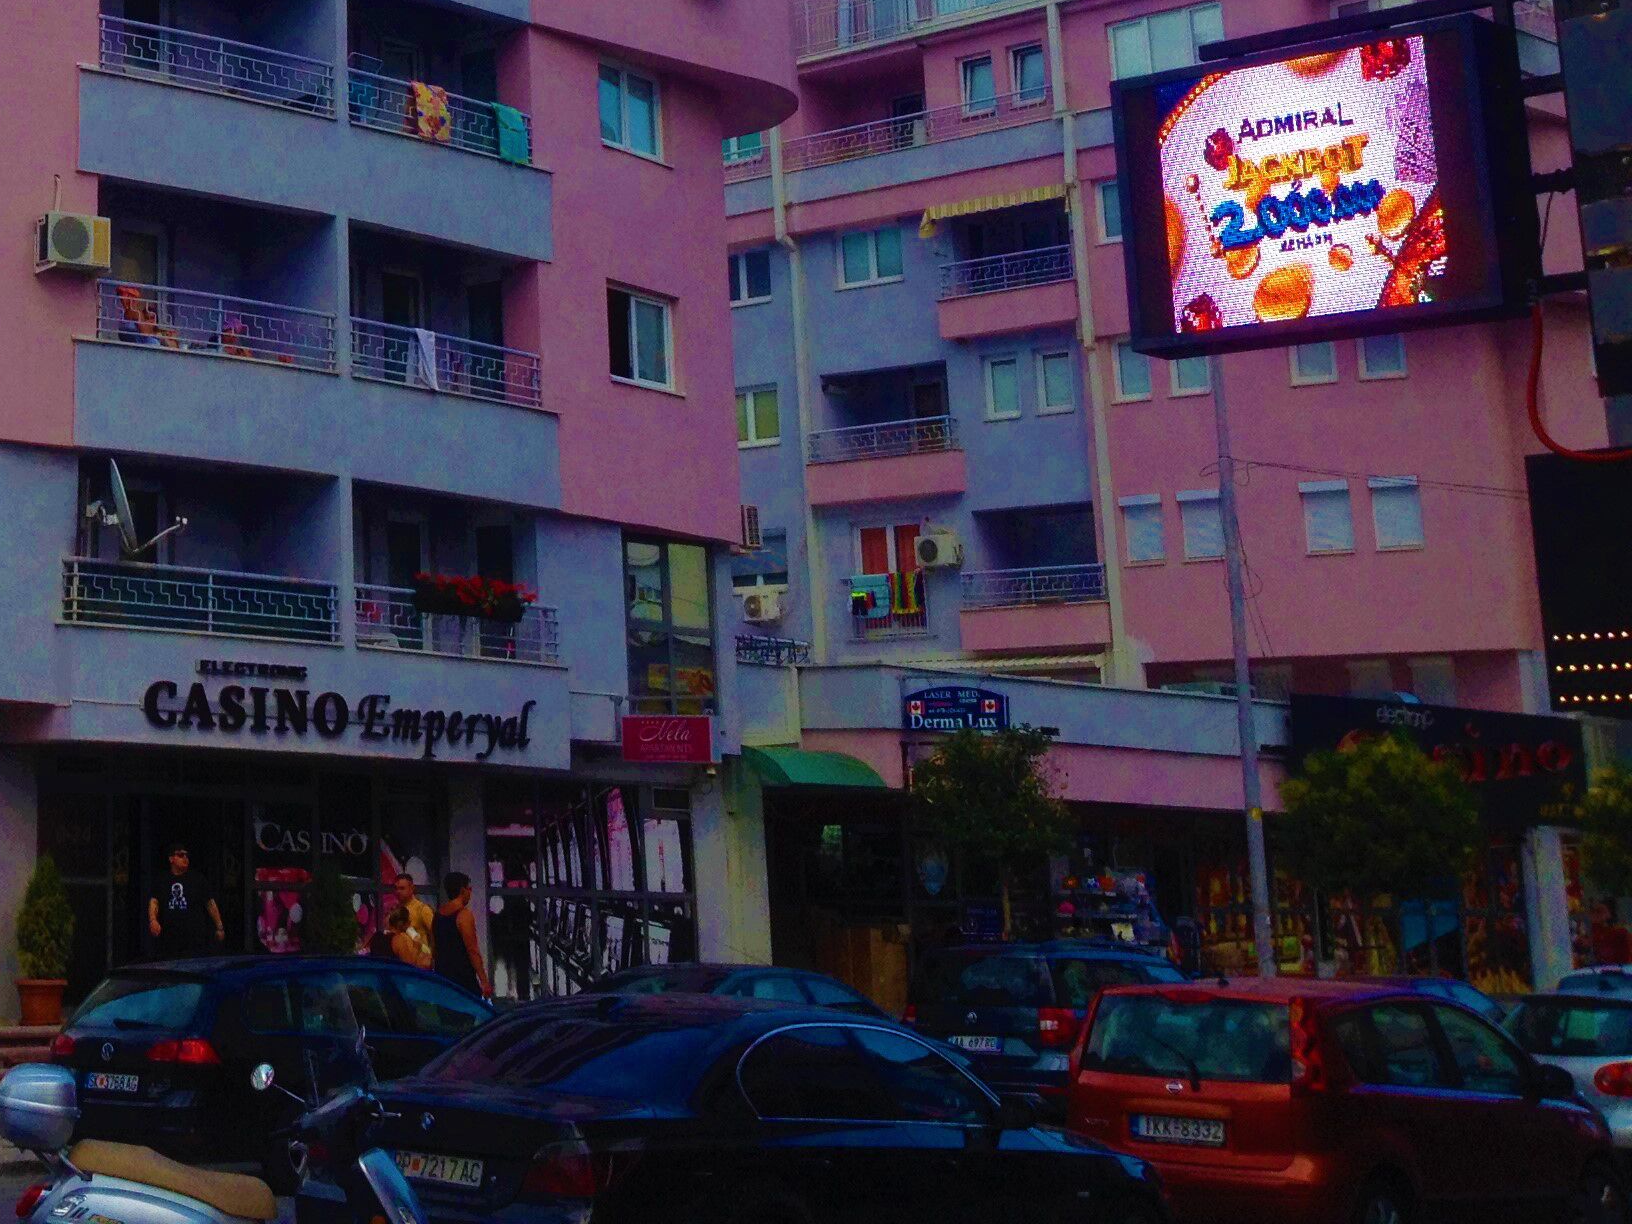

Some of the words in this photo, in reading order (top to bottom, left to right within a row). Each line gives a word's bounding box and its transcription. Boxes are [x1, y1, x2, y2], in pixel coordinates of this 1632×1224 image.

[1237, 102, 1354, 143] ADMIRAL
[1223, 133, 1369, 189] JACKPOT
[924, 690, 952, 699] LASER
[143, 680, 349, 738] CASINO
[358, 693, 537, 758] Emperyal
[910, 714, 963, 729] Derma
[968, 713, 998, 729] Lux
